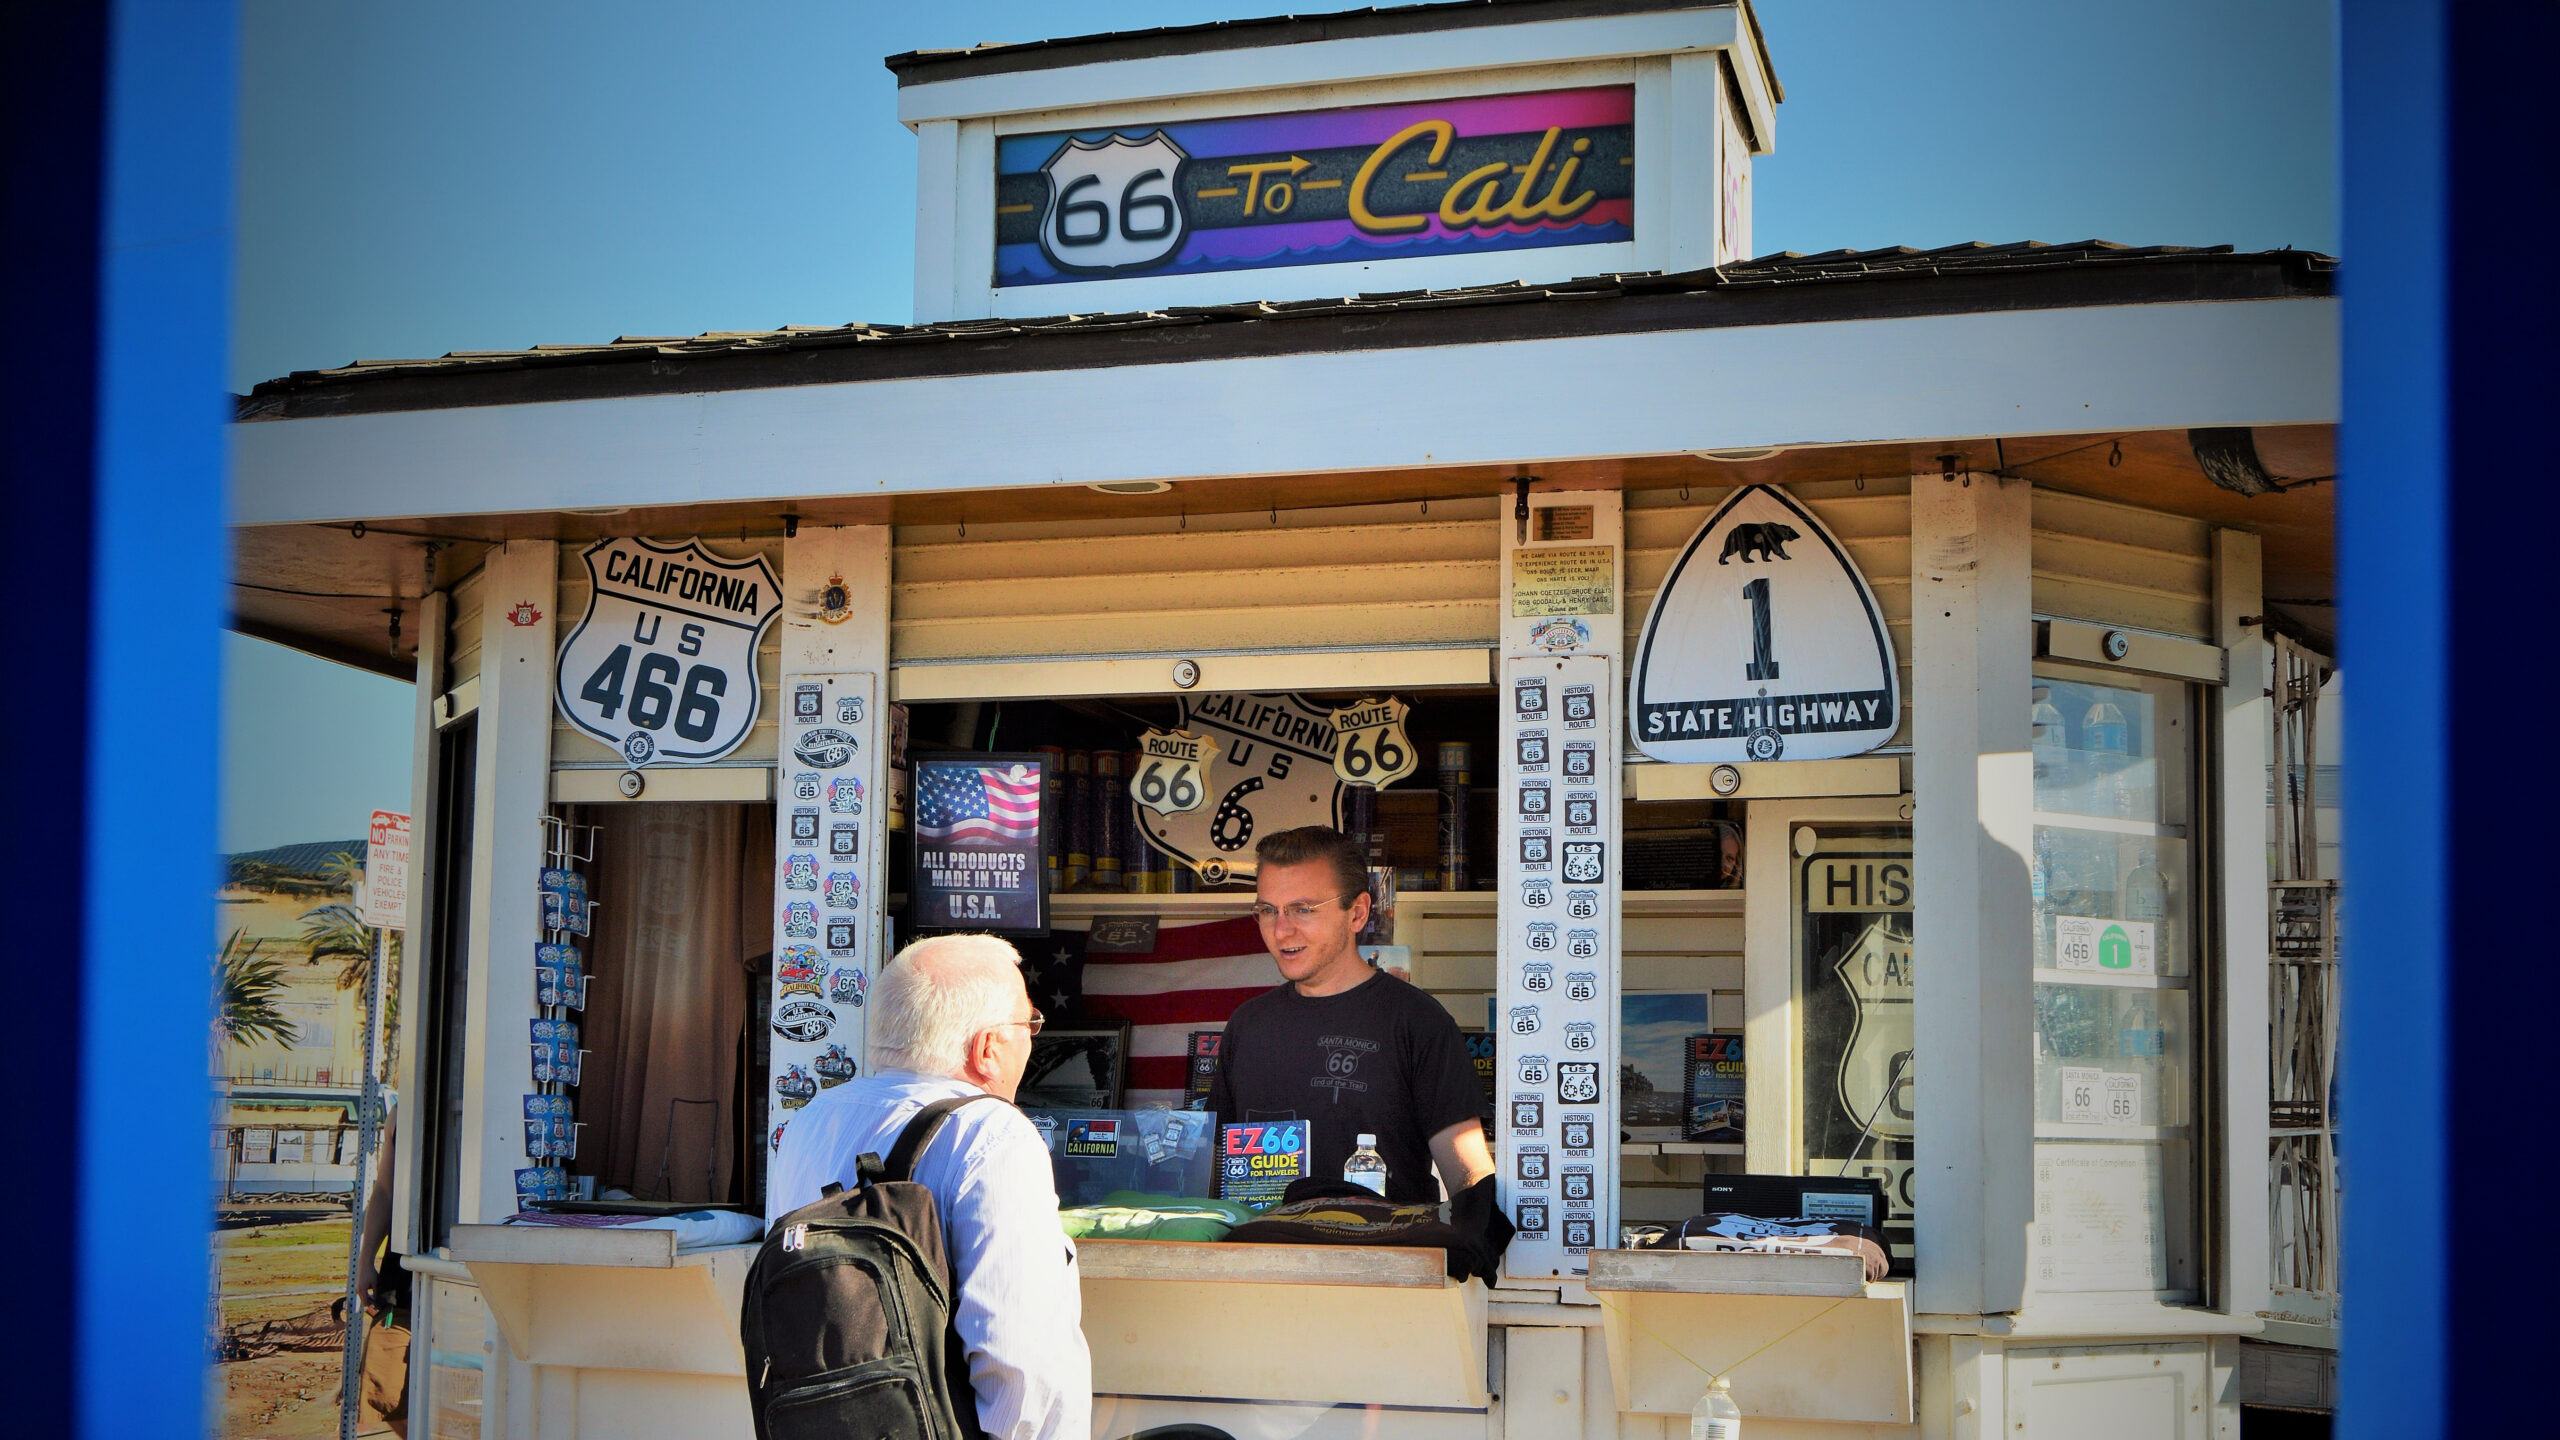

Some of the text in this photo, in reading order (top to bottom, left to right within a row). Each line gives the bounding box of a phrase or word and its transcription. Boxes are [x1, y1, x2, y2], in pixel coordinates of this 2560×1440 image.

[1056, 120, 1597, 246] 66 To Cali
[606, 550, 759, 616] CALIFORNIA
[1743, 577, 1780, 681] 1
[797, 684, 820, 692] HISTORIC
[1518, 678, 1543, 686] HISTORIC
[580, 643, 727, 742] 466
[1564, 686, 1591, 694] HISTORIC
[842, 711, 857, 721] 66
[1339, 706, 1393, 729] ROUTE
[1648, 699, 1880, 734] STATE HIGHWAY
[1201, 695, 1337, 754] CALIFORNI
[1748, 730, 1761, 749] AUTO
[1149, 738, 1199, 758] ROUTE
[1344, 727, 1404, 777] 66
[800, 786, 815, 797] 66
[1140, 761, 1196, 807] 66
[1210, 776, 1264, 851] 6
[372, 827, 409, 847] NO PARKIN
[799, 826, 810, 834] 66
[838, 842, 849, 850] 66
[373, 848, 409, 864] ANY TIME
[923, 851, 1026, 871] ALL PRODUCTS
[379, 863, 394, 874] FIRE
[1568, 856, 1598, 878] 66
[377, 876, 402, 887] POLICE
[932, 869, 1020, 889] MADE IN THE
[1827, 865, 1912, 906] HIS
[372, 887, 406, 900] VEHICLES
[1528, 894, 1546, 904] 66
[374, 899, 402, 911] EXEMPT
[950, 894, 1001, 919] U.S.A.
[1573, 905, 1591, 915] 66
[1533, 937, 1550, 947] 66
[1573, 944, 1591, 955] 66
[2064, 943, 2089, 959] 466
[2112, 944, 2118, 965] 1
[814, 965, 826, 973] 66
[841, 978, 856, 991] 66
[1529, 978, 1546, 988] 66
[1572, 987, 1589, 997] 66
[1517, 1021, 1534, 1032] 66
[1318, 1036, 1378, 1051] SANTA MONICA
[1571, 1037, 1589, 1048] 66
[1695, 1039, 1743, 1060] EZ6
[1199, 1063, 1210, 1071] 66
[1328, 1052, 1356, 1073] 66
[1716, 1061, 1744, 1072] GUI
[1525, 1070, 1542, 1080] 66
[1314, 1078, 1325, 1086] End
[1349, 1080, 1363, 1090] Trail
[1564, 1076, 1593, 1098] 66
[2075, 1087, 2090, 1107] 66
[2113, 1100, 2130, 1115] 66
[1068, 1142, 1115, 1154] CALIFORNIA
[1227, 1126, 1300, 1155] EZ66
[1250, 1154, 1299, 1169] GUIDE
[1230, 1165, 1244, 1175] 66
